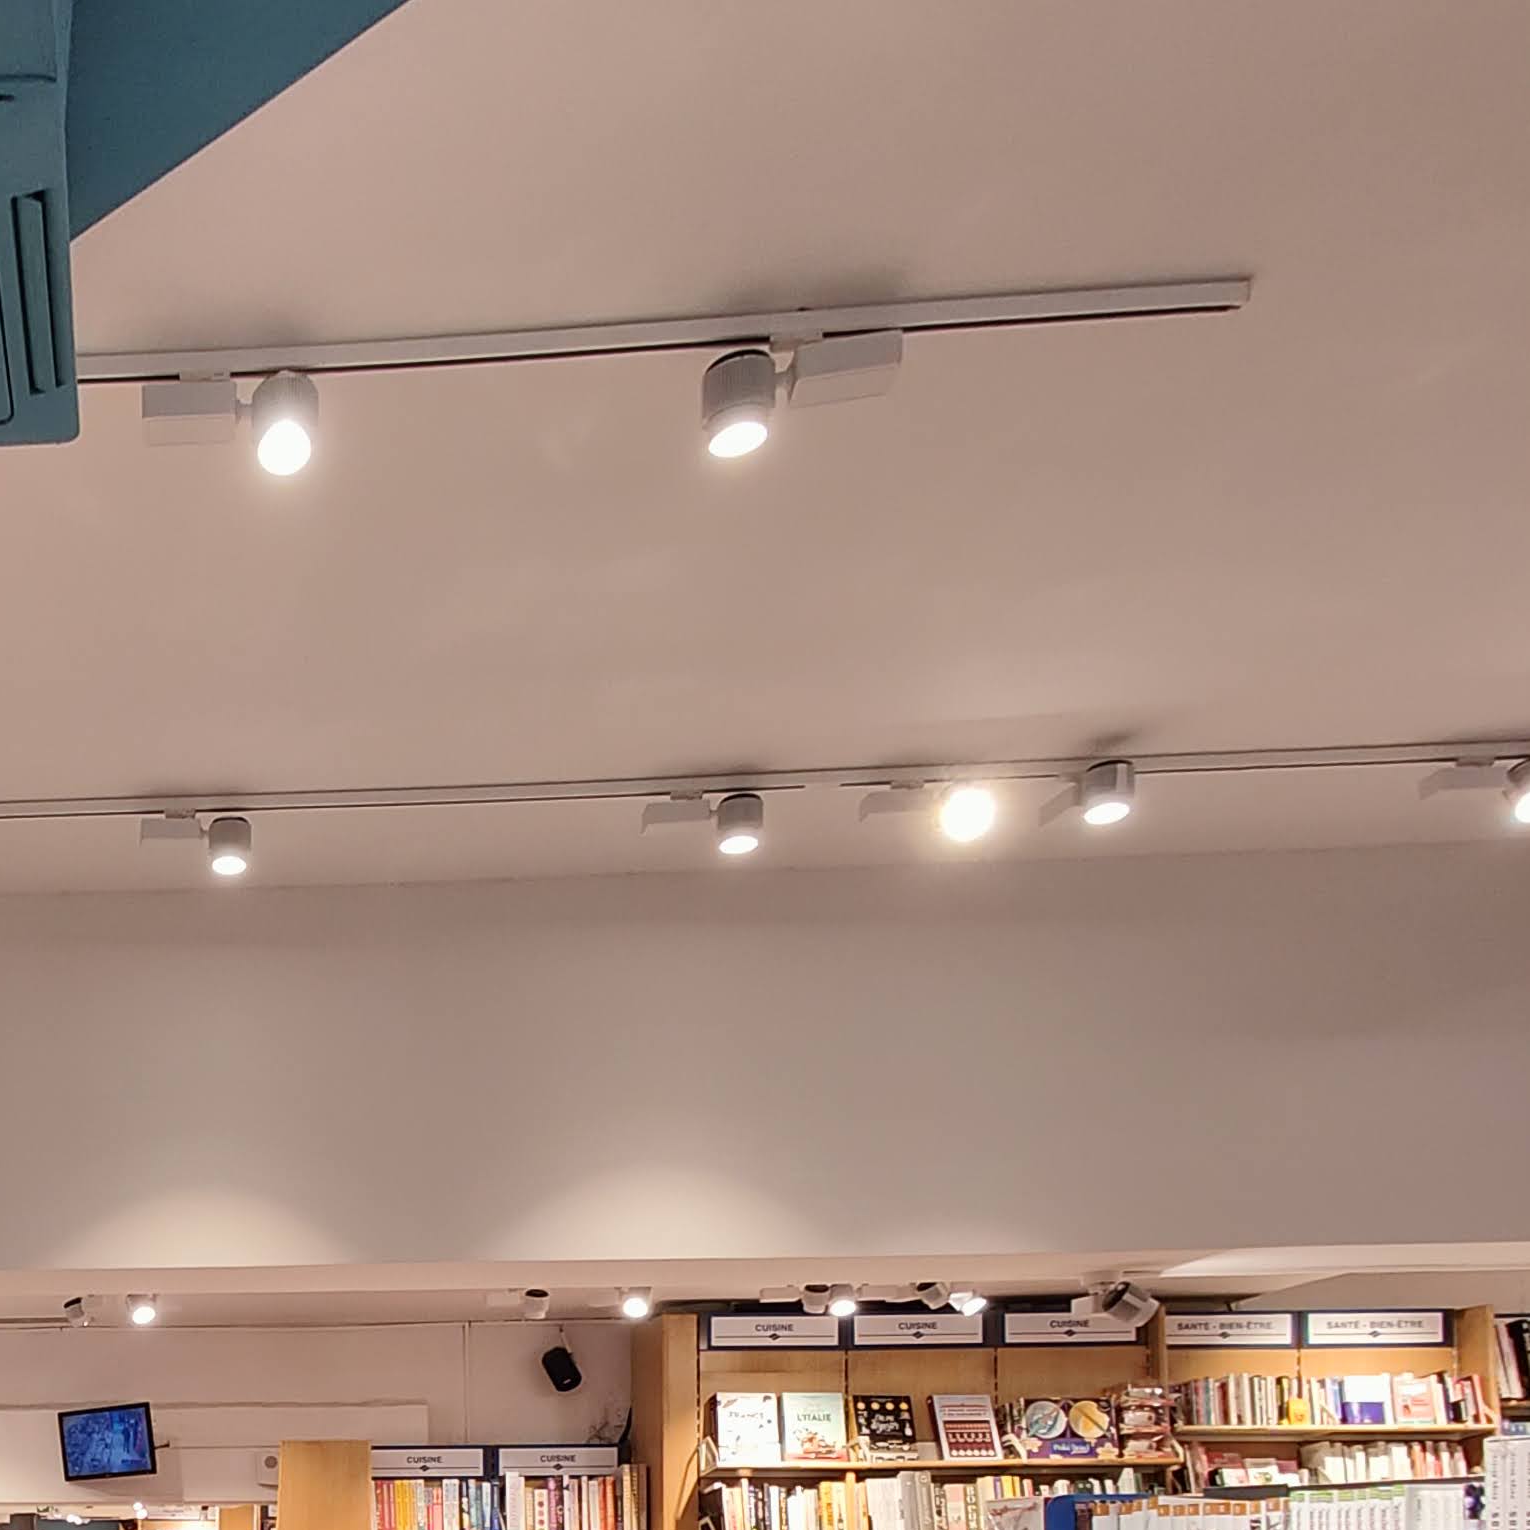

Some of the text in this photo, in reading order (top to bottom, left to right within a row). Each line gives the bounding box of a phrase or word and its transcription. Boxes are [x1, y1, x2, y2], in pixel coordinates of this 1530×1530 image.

[754, 1324, 794, 1332] CUISINE
[898, 1321, 937, 1330] CUISINE
[1050, 1319, 1089, 1328] CUISINE
[1177, 1319, 1208, 1331] SANTÉ
[1326, 1318, 1359, 1330] SANTÉ
[406, 1456, 443, 1464] CUISINE
[540, 1454, 576, 1463] CUISINE
